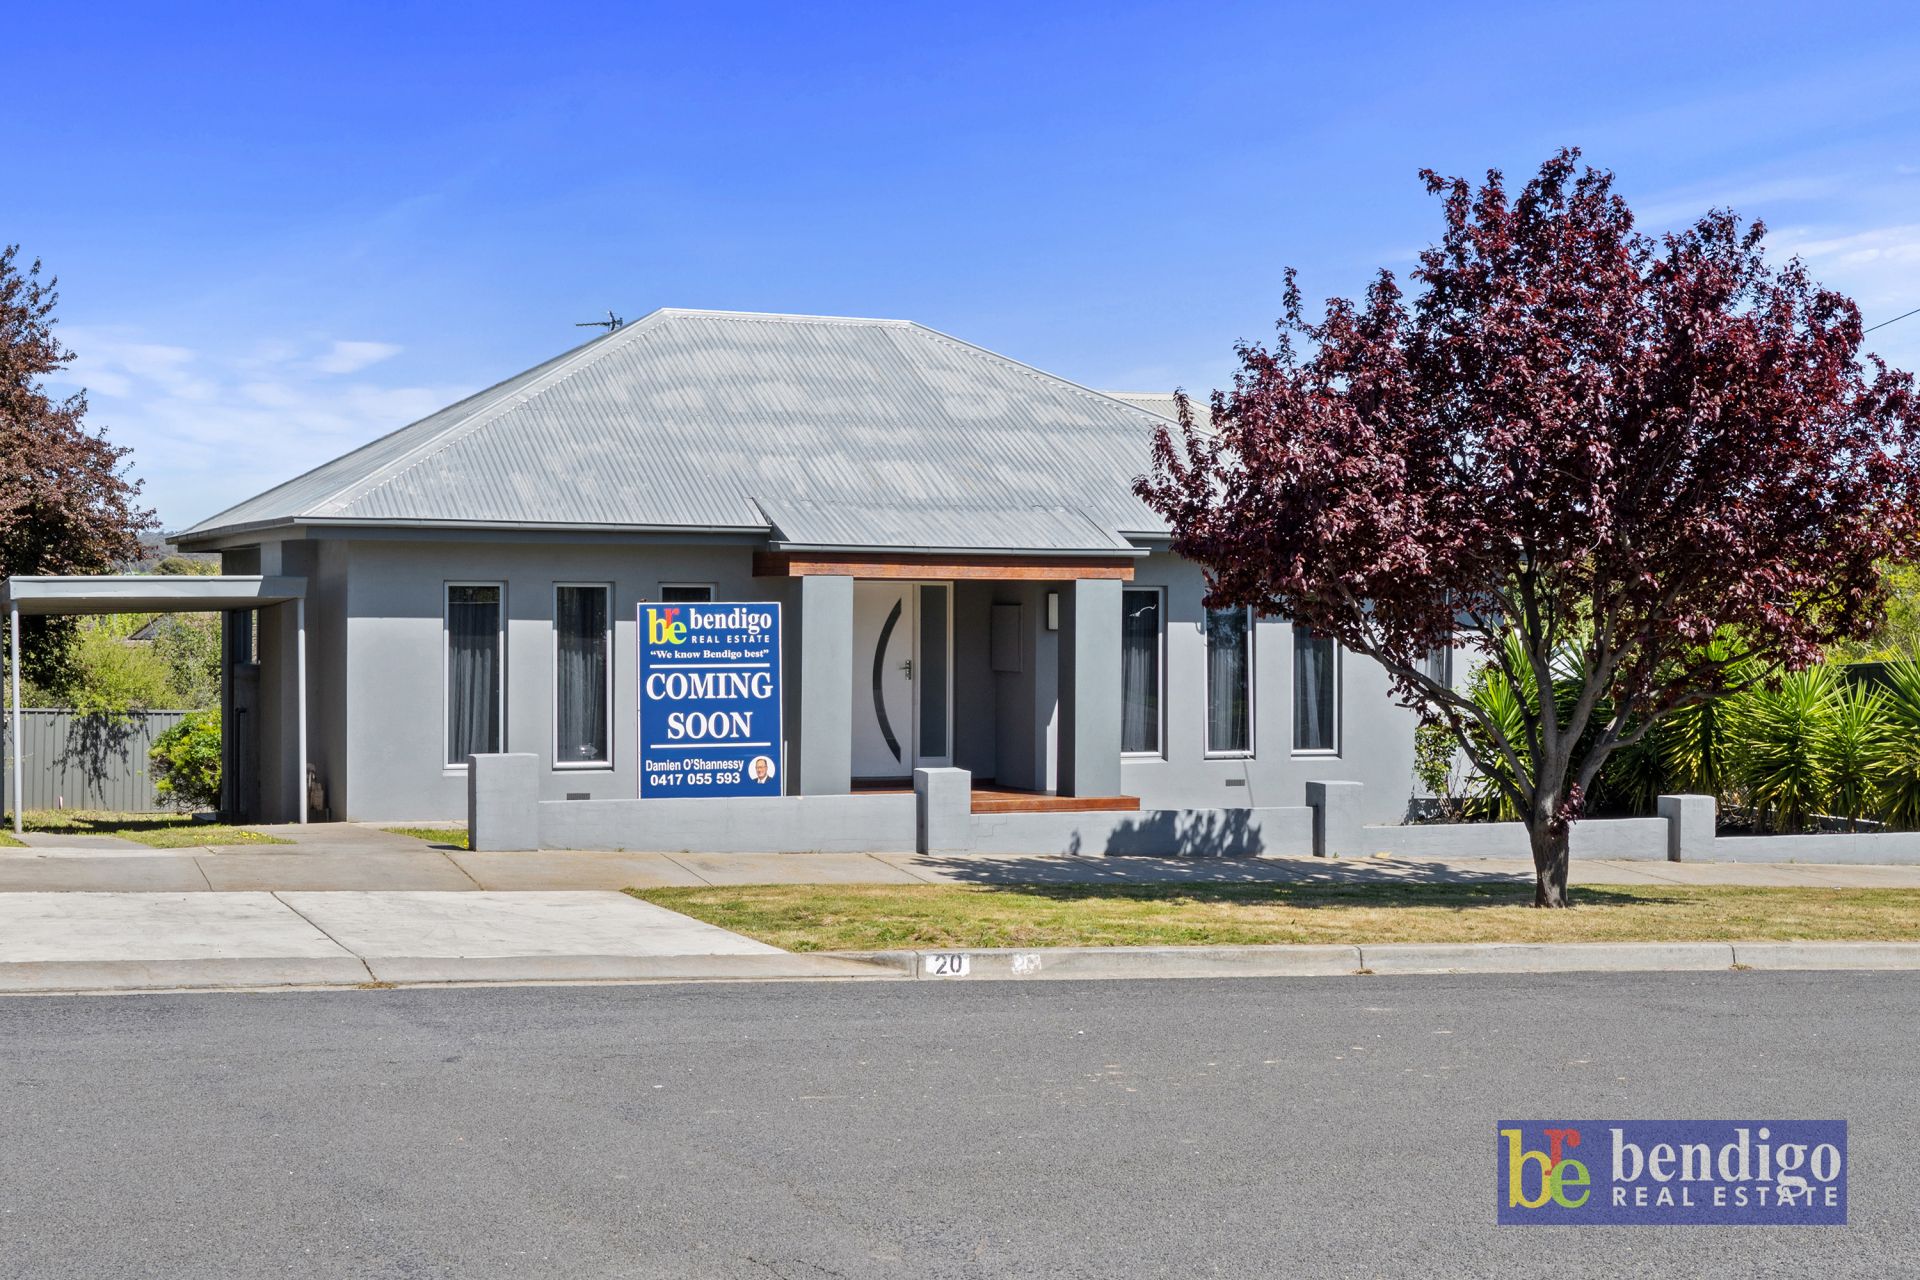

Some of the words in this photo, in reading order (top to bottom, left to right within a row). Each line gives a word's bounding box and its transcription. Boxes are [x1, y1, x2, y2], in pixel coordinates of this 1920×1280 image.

[689, 608, 772, 635] bendigo
[692, 635, 720, 643] REAL
[727, 635, 770, 643] ESTATE
[674, 649, 700, 659] know
[703, 649, 742, 659] Bendigo
[646, 672, 773, 700] COMING
[667, 711, 753, 739] SOON
[645, 759, 681, 771] Damien
[650, 773, 683, 786] 0417
[687, 773, 712, 785] 055
[716, 772, 741, 784] 593
[935, 954, 962, 974] 20
